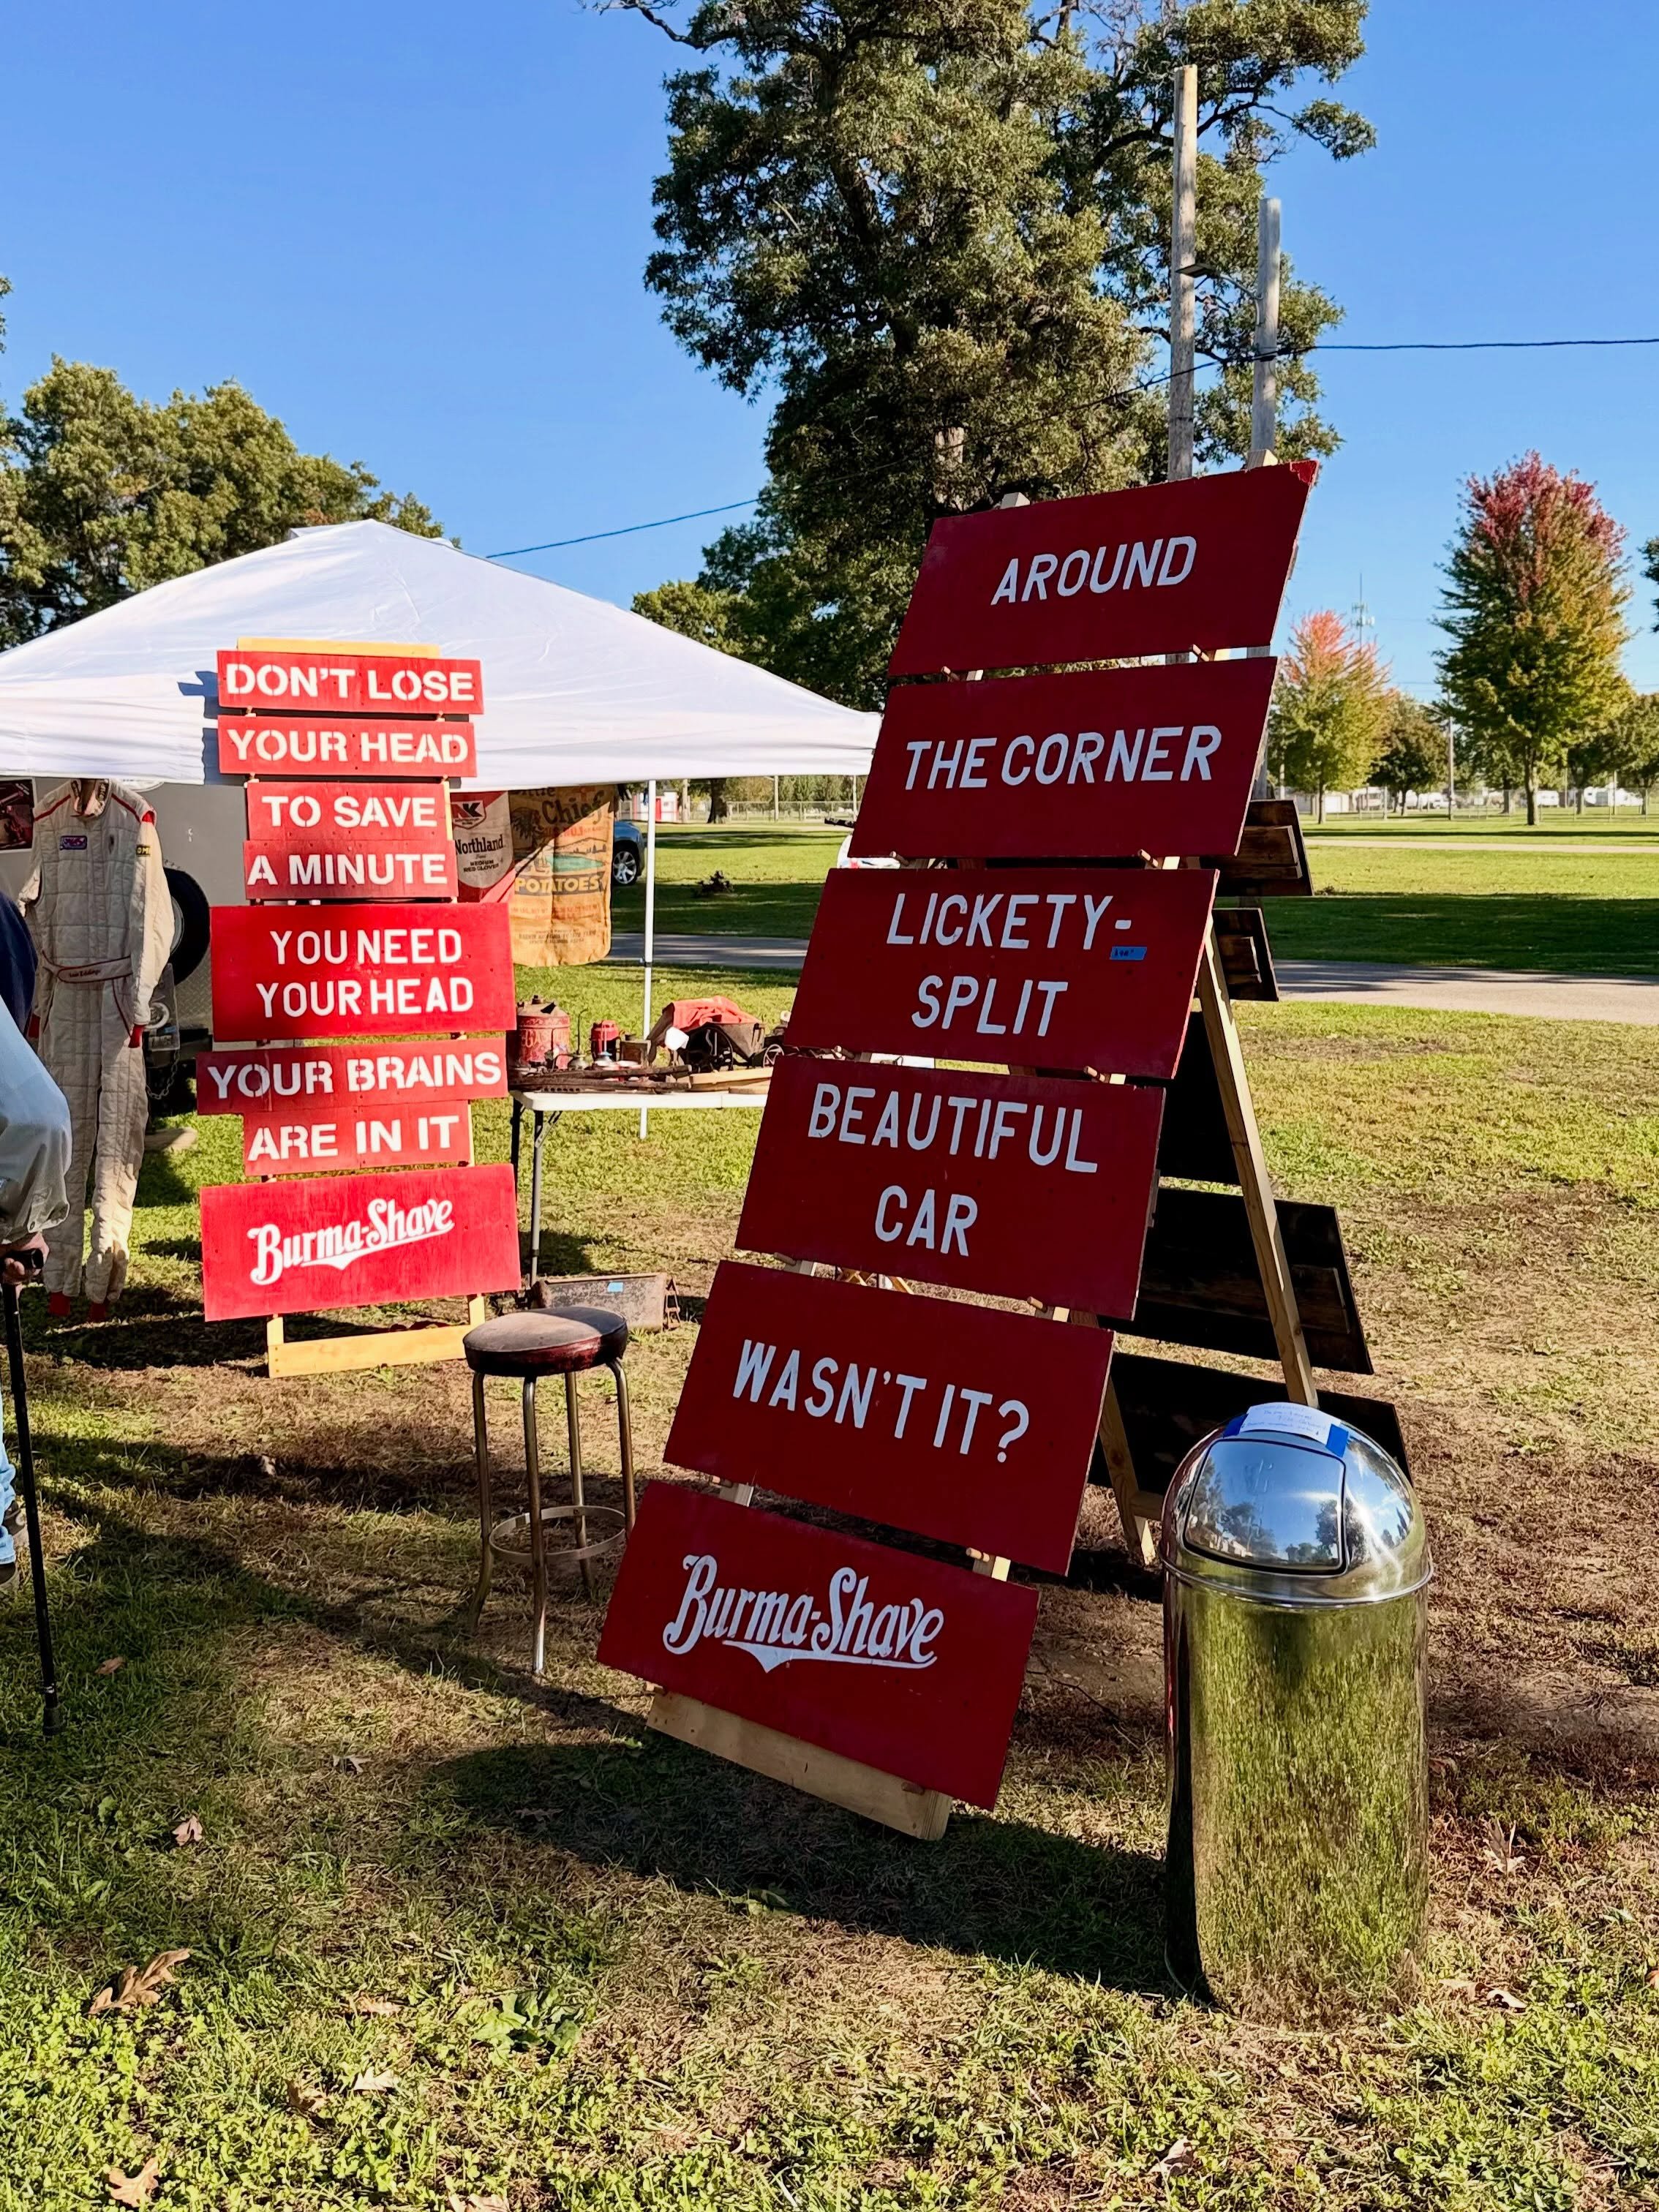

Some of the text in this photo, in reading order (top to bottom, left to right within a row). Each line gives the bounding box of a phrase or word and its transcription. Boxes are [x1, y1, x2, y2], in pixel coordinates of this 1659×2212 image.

[991, 536, 1197, 606] AROUND
[226, 663, 475, 701] DON'T LOSE
[227, 729, 469, 764] YOUR HEAD
[905, 726, 1222, 791] THE CORNER
[261, 795, 438, 827] TO SAVE
[542, 790, 605, 824] Chief
[455, 834, 504, 854] Northland
[247, 853, 448, 886] A MINUTE
[515, 876, 600, 893] POTATOES
[887, 893, 1132, 950] LICKETY-
[270, 929, 462, 965] YOU NEED
[256, 977, 474, 1018] YOUR HEAD
[911, 975, 1069, 1037] SPLIT
[207, 1052, 503, 1099] YOUR BRAINS
[247, 1116, 459, 1162] ARE IN IT
[808, 1083, 1098, 1173] BEAUTIFUL
[247, 1197, 454, 1286] Burma-Shave
[875, 1186, 978, 1257] CAR
[733, 1339, 1030, 1463] WASN'T IT?
[663, 1554, 944, 1671] Burma-Shave
